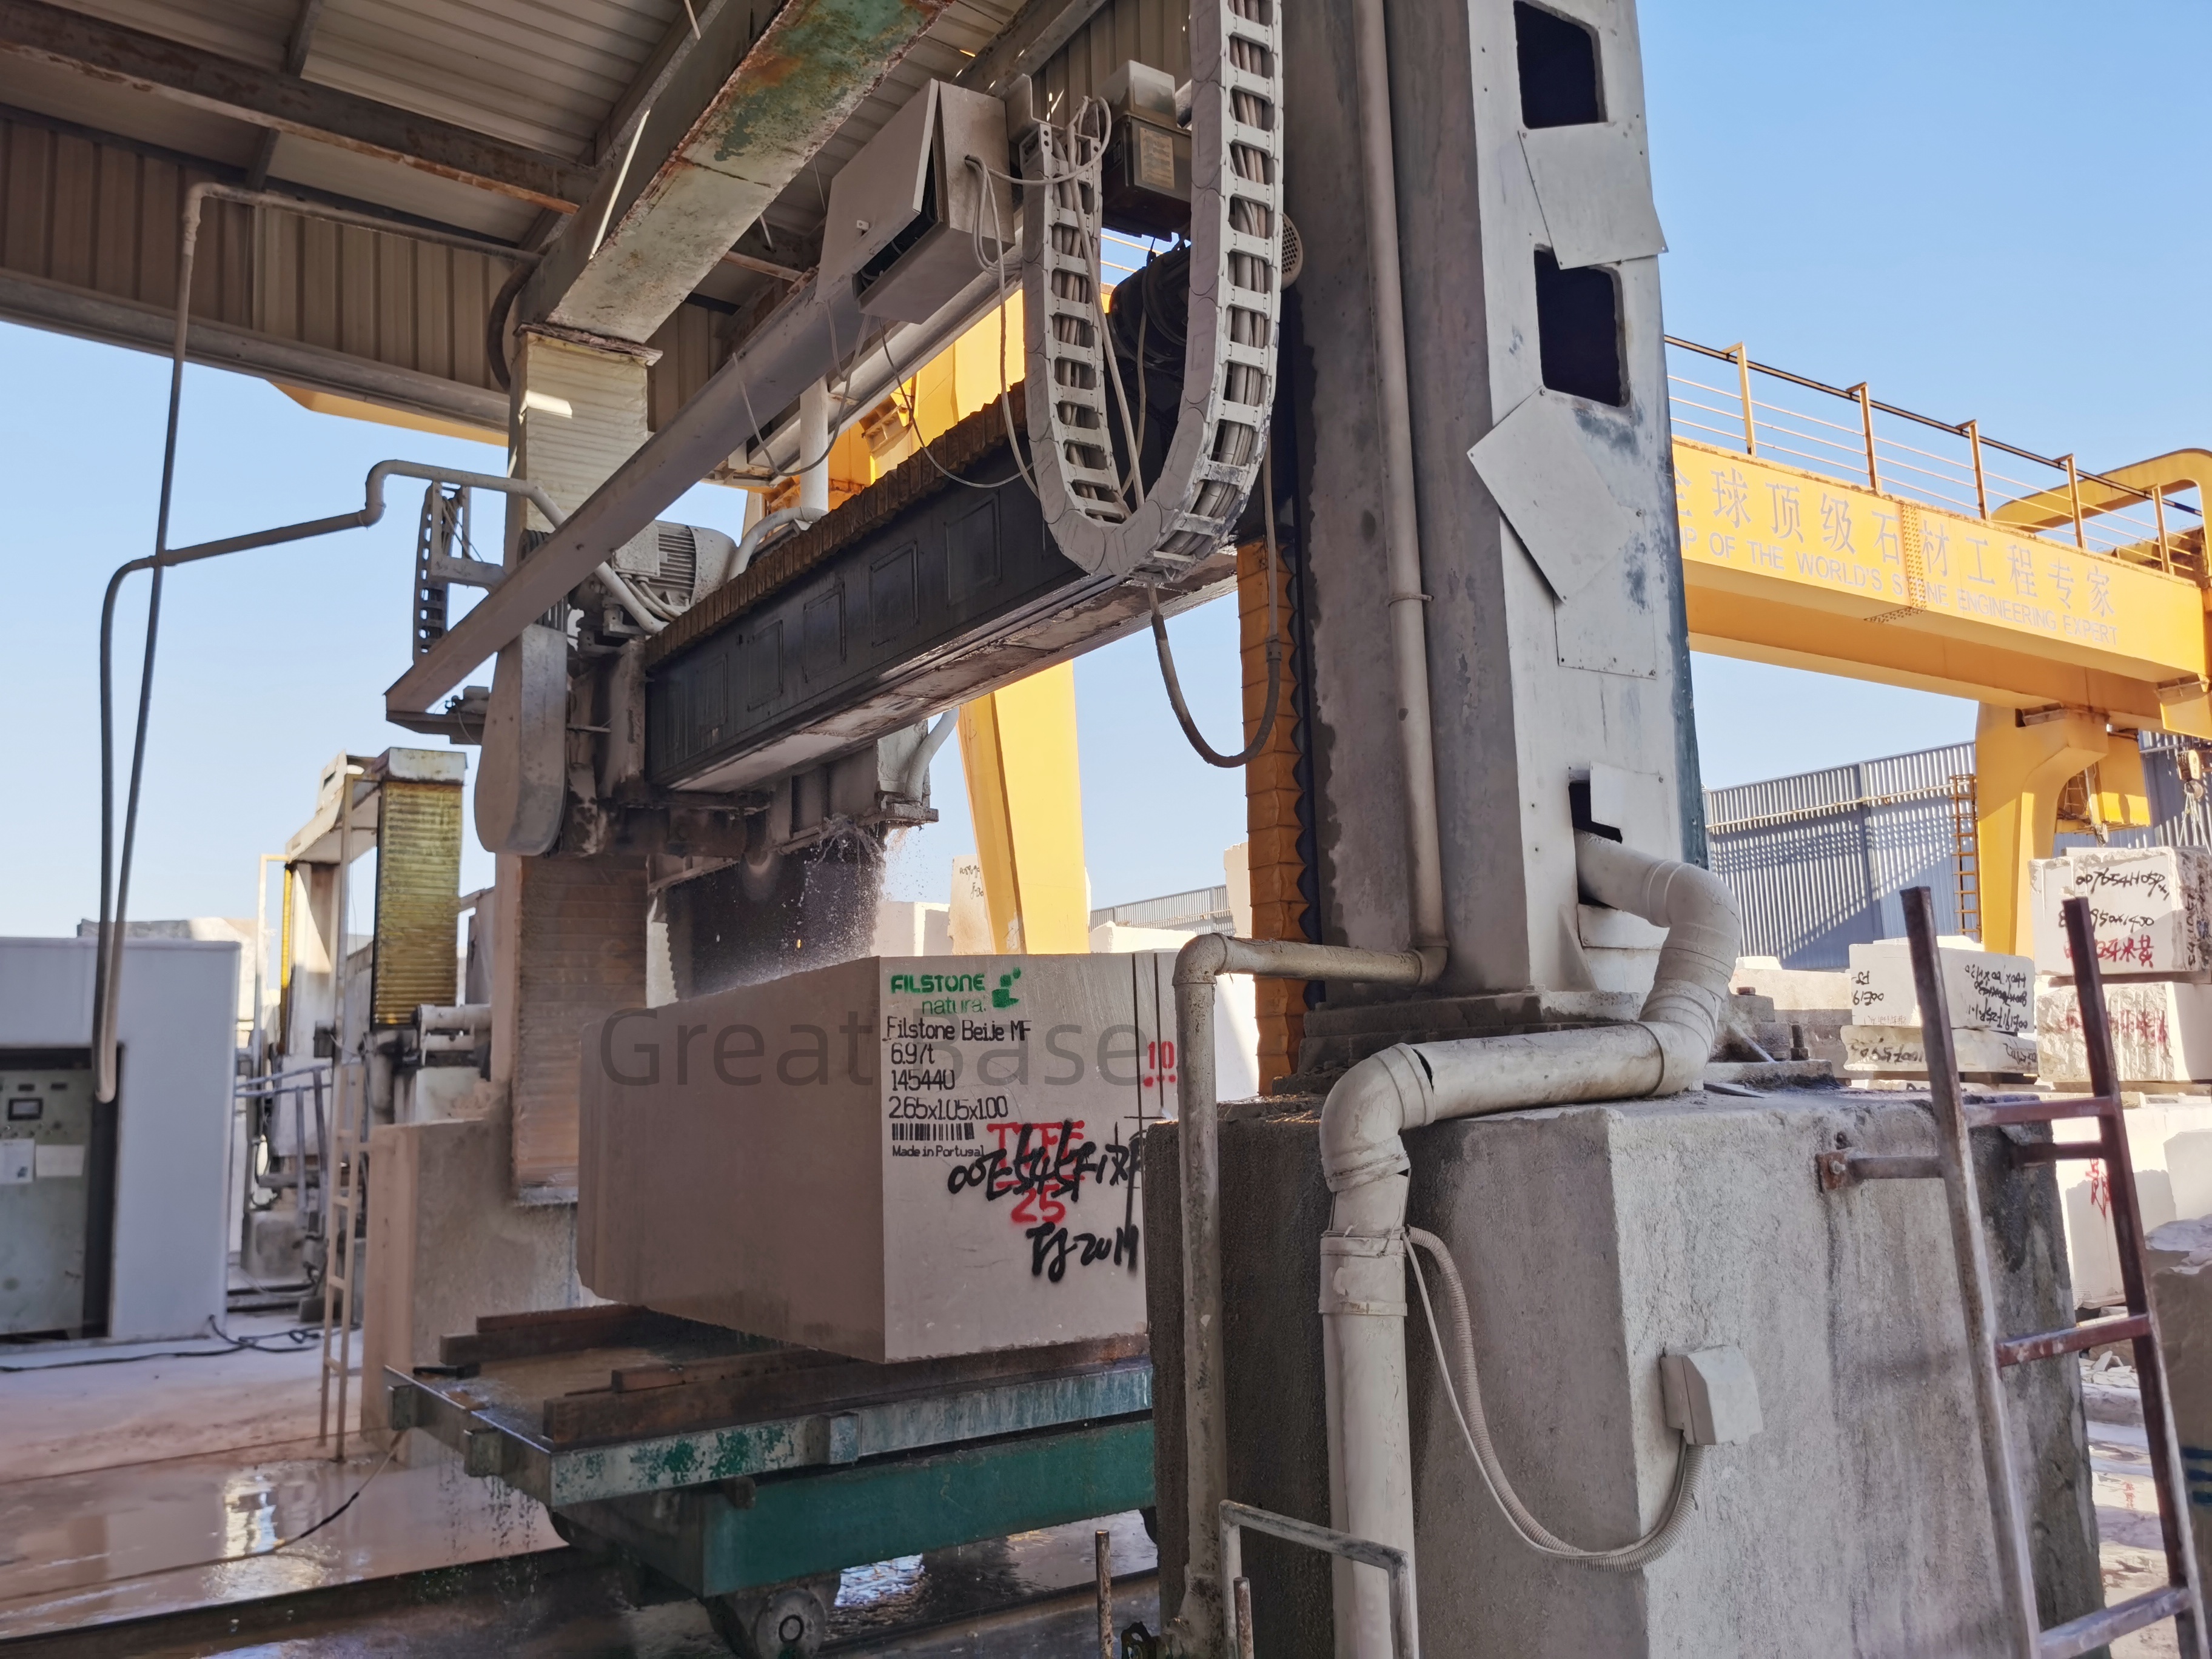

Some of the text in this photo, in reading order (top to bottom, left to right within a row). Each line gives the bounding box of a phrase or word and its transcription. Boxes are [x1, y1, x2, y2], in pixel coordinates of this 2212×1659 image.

[1709, 532, 1735, 559] OF
[1746, 540, 1785, 571] THE
[1795, 551, 1883, 592] WORLD'S
[1956, 588, 2057, 631] ENGINEERING
[2062, 614, 2118, 646] EXPERT
[891, 973, 986, 994] FILSTONE
[922, 996, 987, 1014] natura
[886, 1015, 956, 1041] Filstone
[1010, 1020, 1032, 1042] MF
[1148, 1041, 1175, 1070] 10
[891, 1069, 955, 1091] 145440
[892, 1144, 985, 1157] Made in Portugal
[1010, 1183, 1067, 1224] 25
